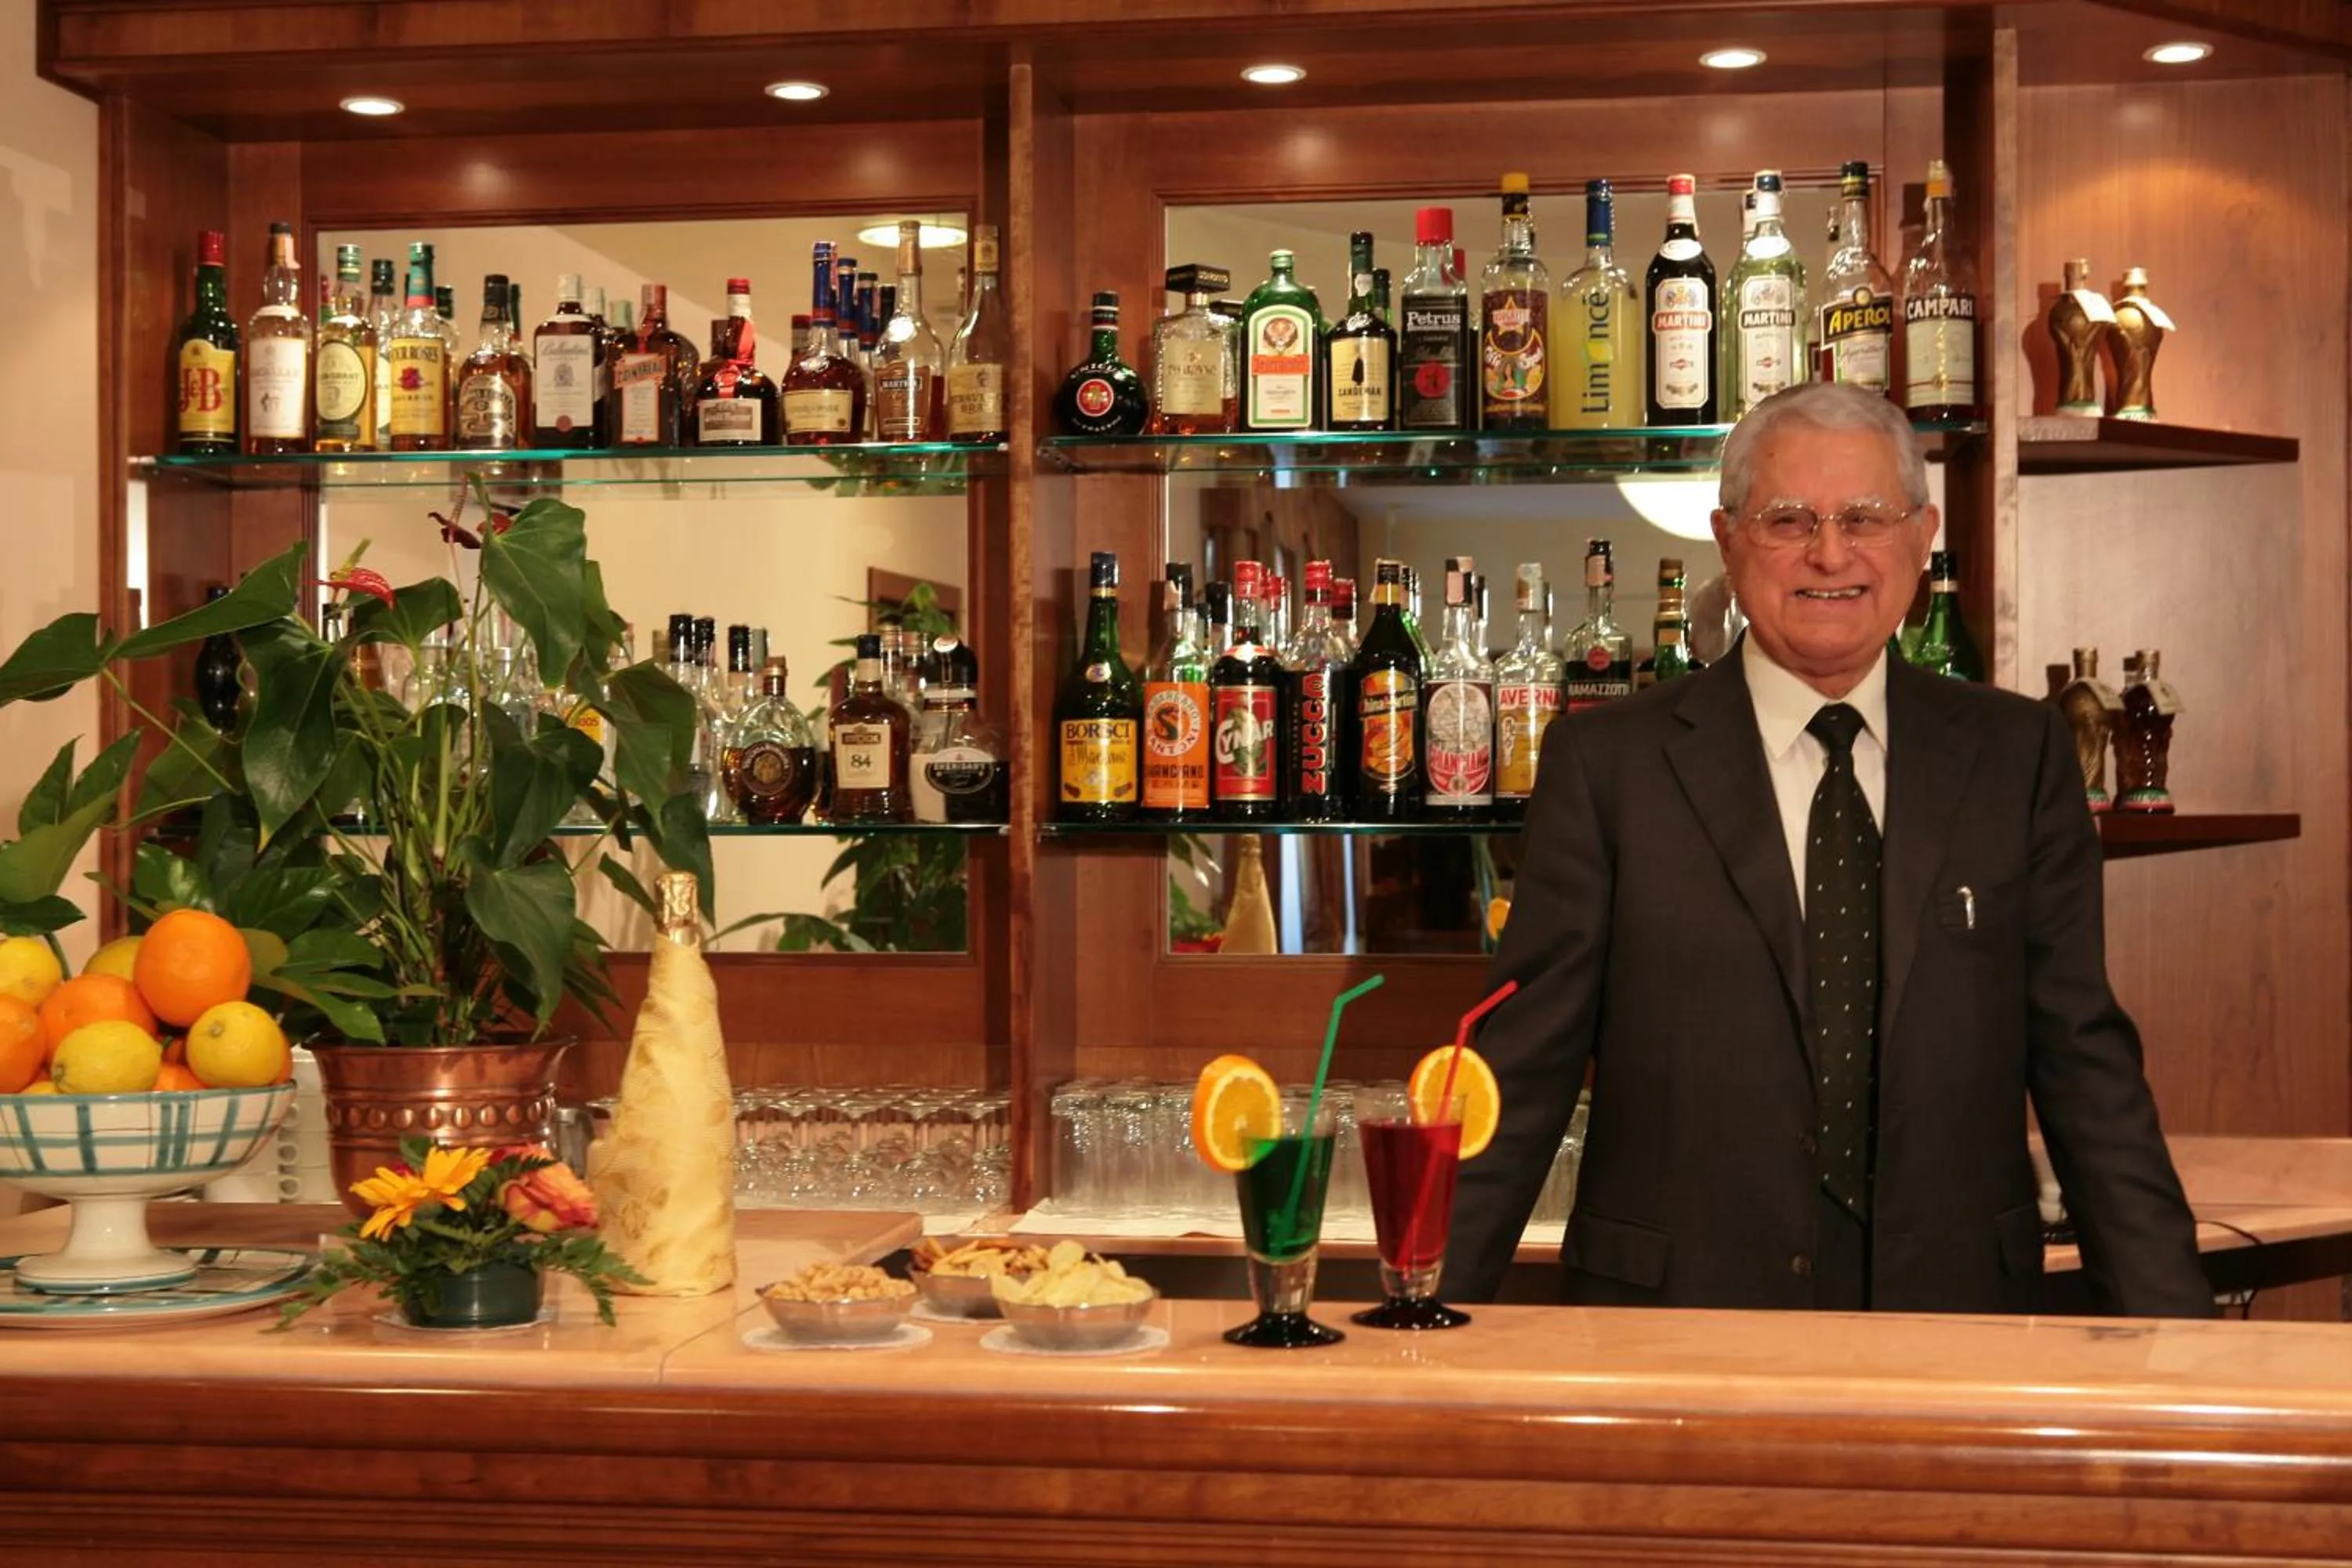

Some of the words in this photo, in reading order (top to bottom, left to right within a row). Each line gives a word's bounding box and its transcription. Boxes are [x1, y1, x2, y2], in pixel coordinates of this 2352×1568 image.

[1907, 296, 1973, 319] CAMPARI
[1406, 310, 1461, 325] Petrus
[1657, 313, 1706, 328] MARTINI
[1743, 311, 1793, 327] MARTINI
[1499, 689, 1560, 705] AVERNA
[1065, 722, 1130, 739] BORSCI
[850, 754, 873, 768] 84
